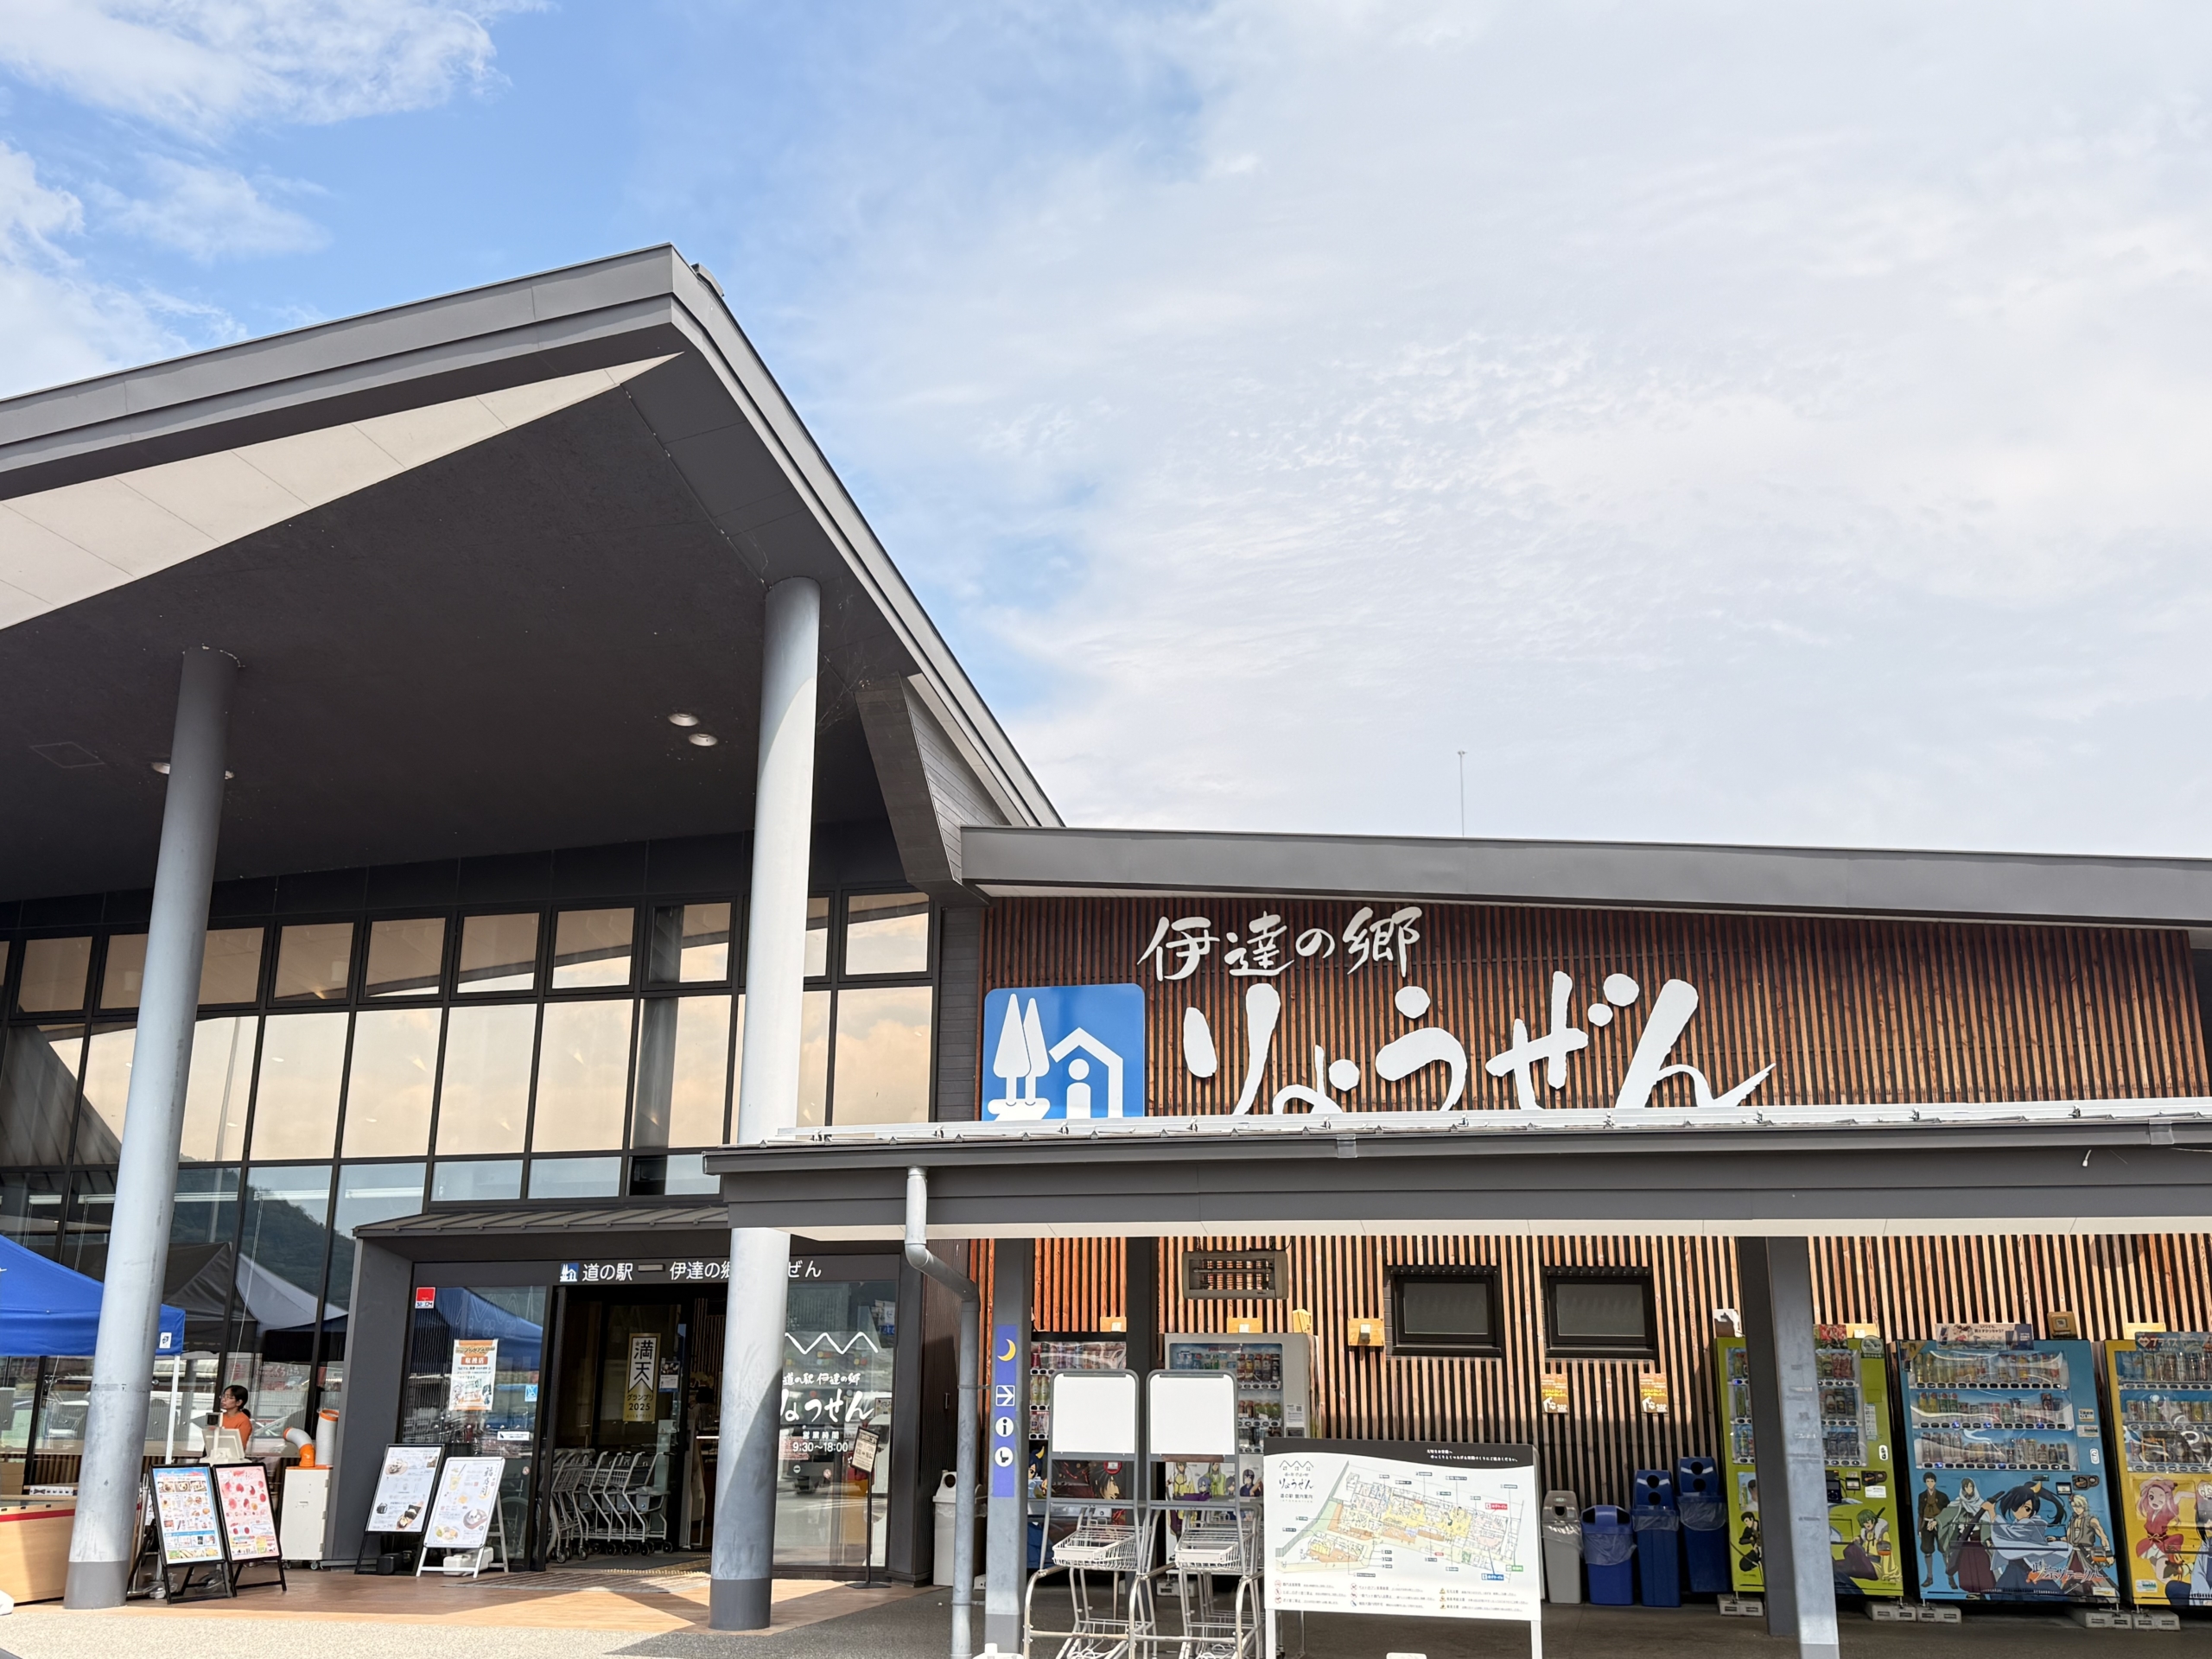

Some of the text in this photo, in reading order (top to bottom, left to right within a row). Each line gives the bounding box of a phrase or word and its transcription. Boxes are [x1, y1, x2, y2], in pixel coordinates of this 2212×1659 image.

[1138, 906, 1422, 982] 伊達の郷
[1183, 970, 1775, 1115] りょうぜん
[582, 1262, 633, 1281] 道の駅
[633, 1340, 654, 1381] 満天
[626, 1393, 653, 1402] グランプリ
[802, 1430, 840, 1440] 営業時間
[1279, 1478, 1314, 1490] りょうぜん
